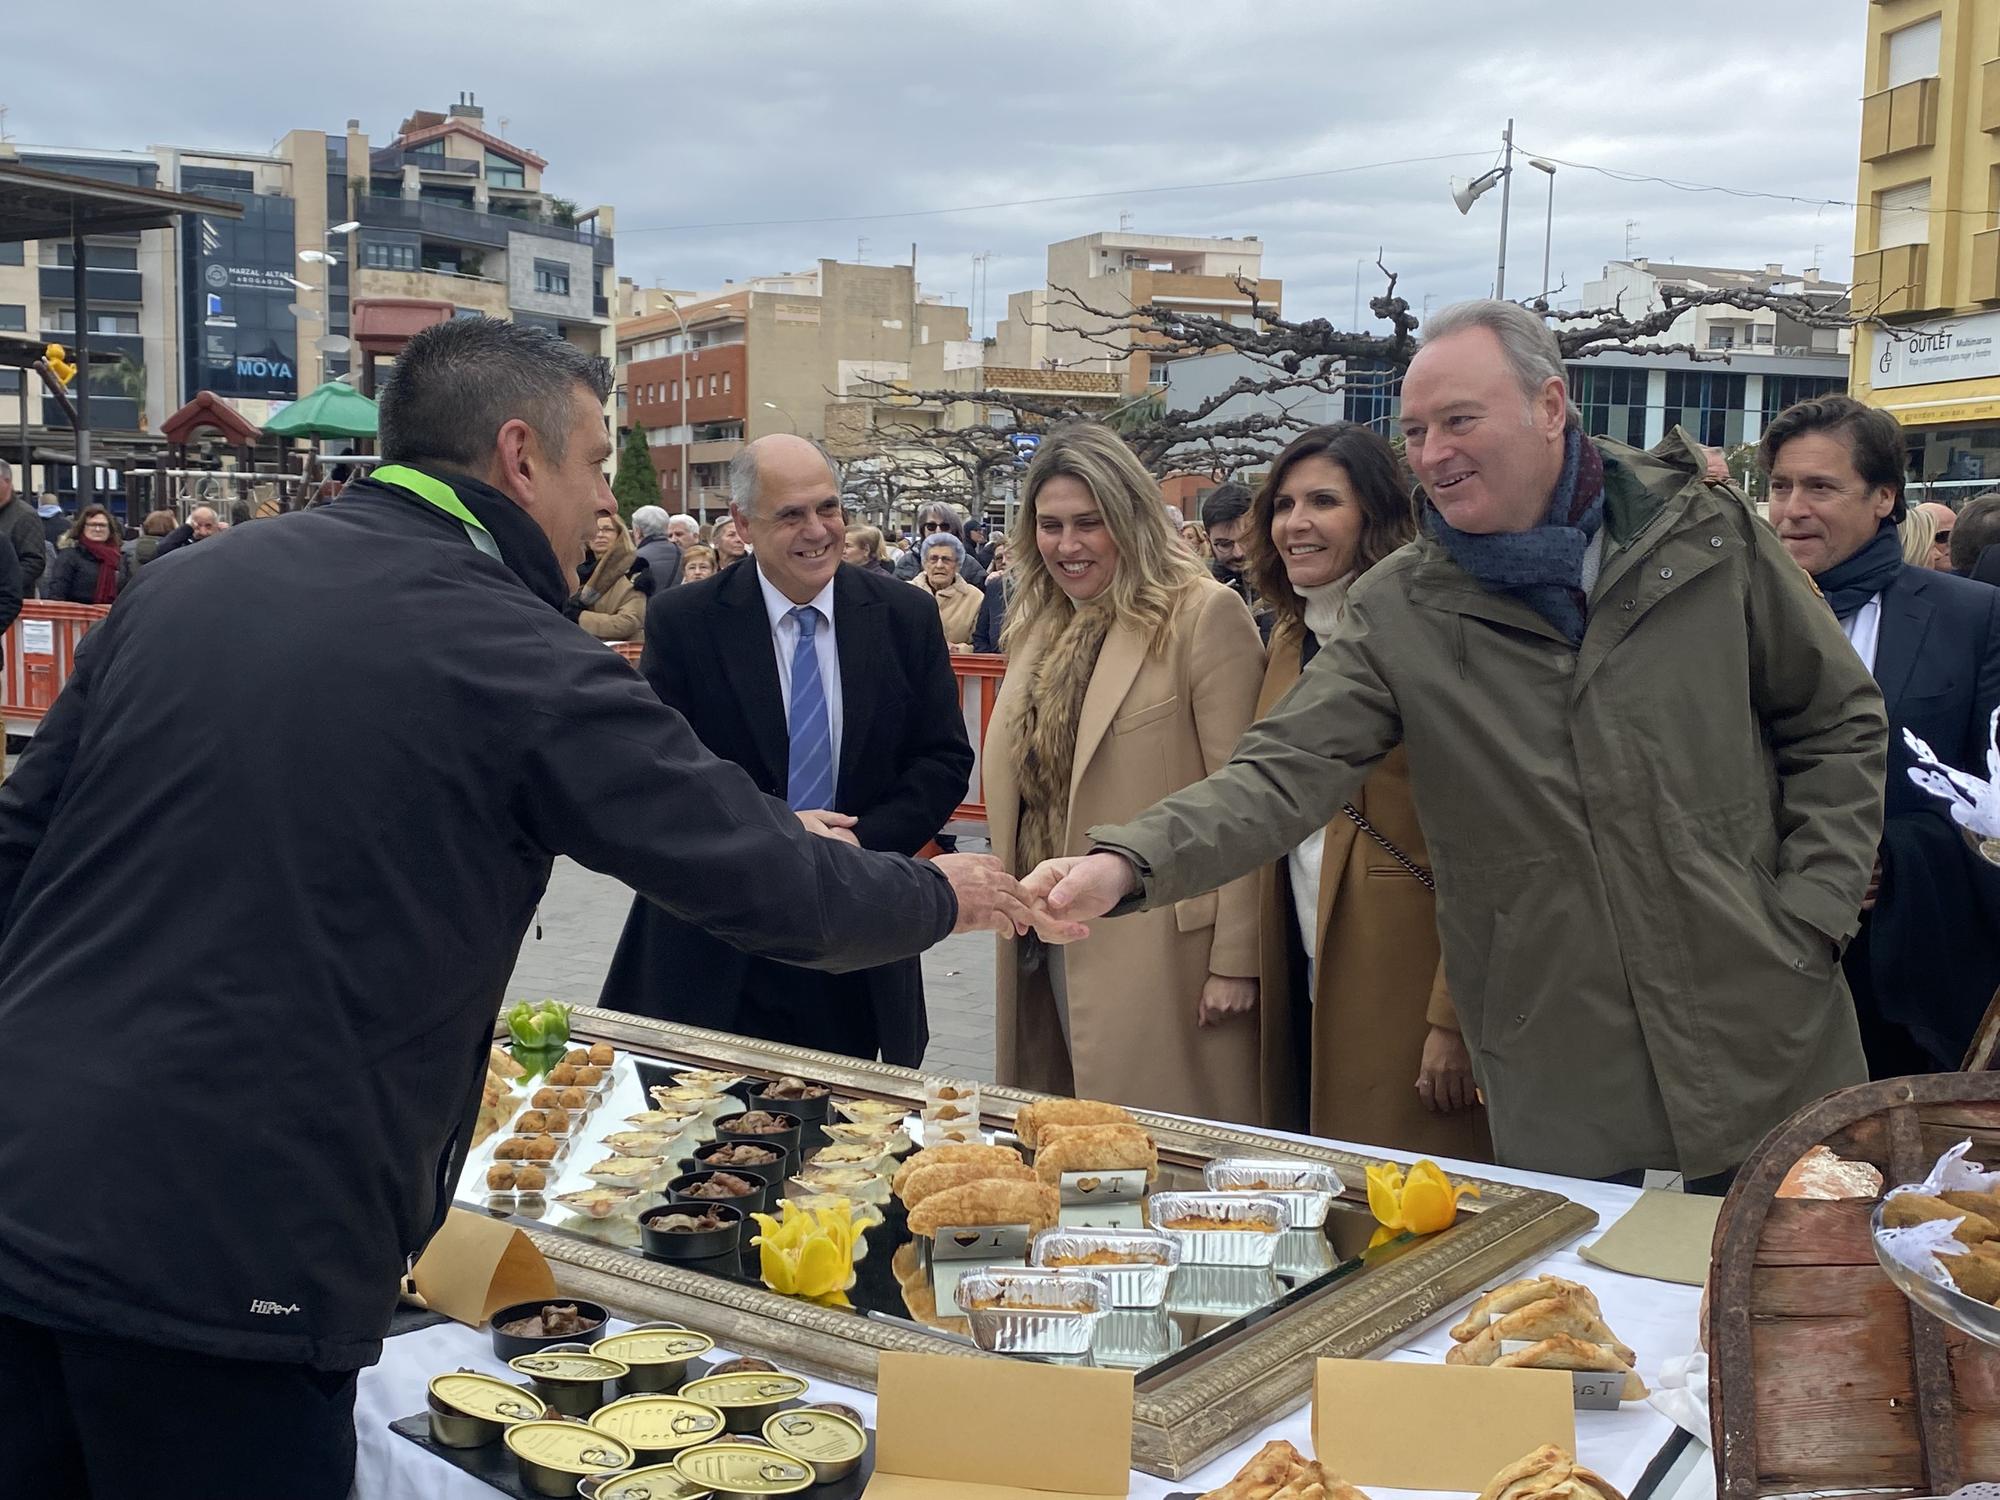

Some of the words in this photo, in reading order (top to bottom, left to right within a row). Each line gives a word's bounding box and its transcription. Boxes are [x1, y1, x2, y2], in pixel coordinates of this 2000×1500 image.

[229, 268, 260, 277] MARZAL
[237, 277, 284, 286] ABOGADOS
[1909, 334, 1952, 353] OUTLET
[237, 361, 292, 378] MOYA
